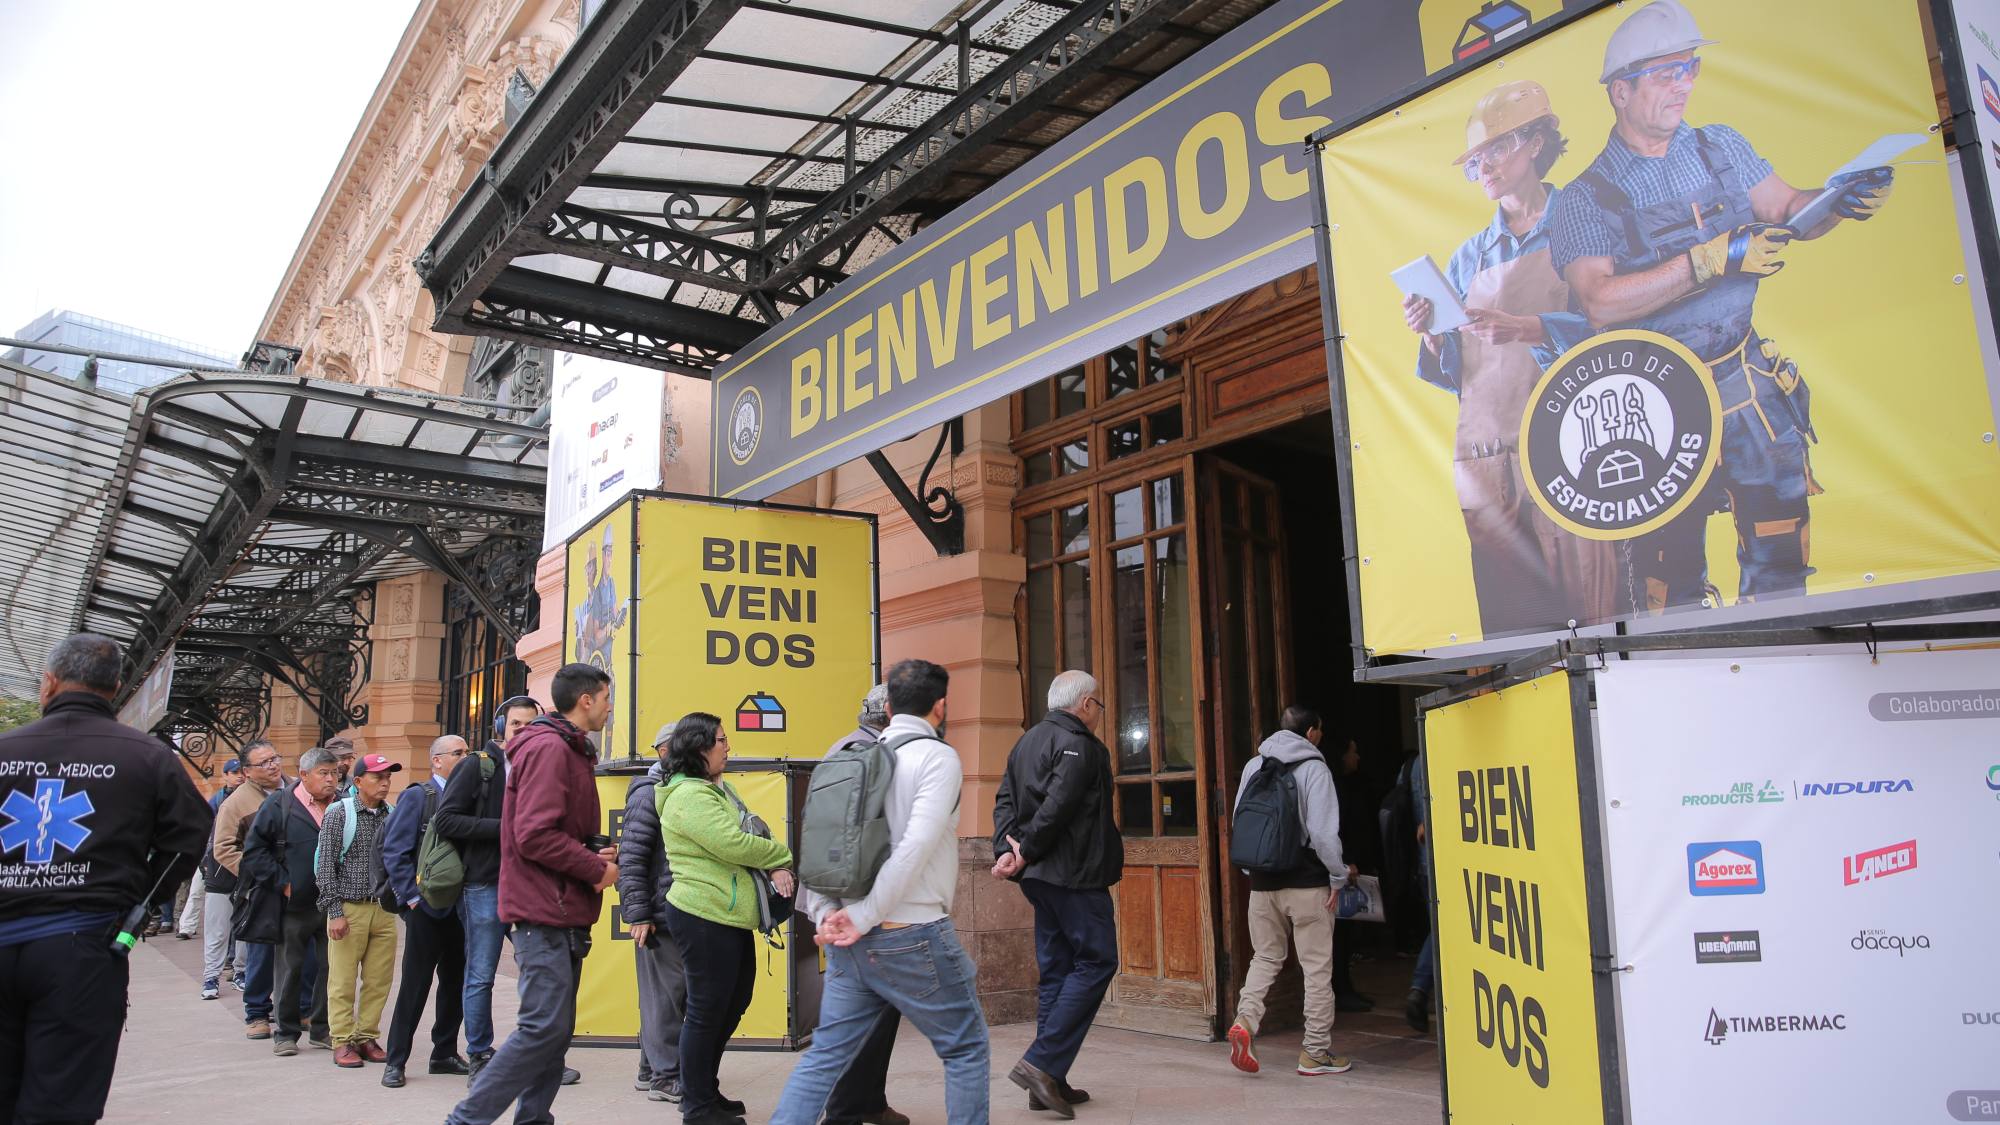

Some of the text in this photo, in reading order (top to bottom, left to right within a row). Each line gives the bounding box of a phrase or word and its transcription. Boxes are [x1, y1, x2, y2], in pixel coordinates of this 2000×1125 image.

[790, 62, 1333, 439] BIENVENIDOS
[1546, 351, 1674, 414] CIRCULO DE
[1546, 432, 1703, 523] ESPECIALISTAS
[702, 536, 817, 579] BIEN
[699, 582, 817, 624] VENI
[706, 629, 815, 669] DOS
[0, 760, 116, 778] DEPTO. MEDICO
[1730, 782, 1754, 793] AIR
[1802, 779, 1914, 797] INDURA
[1457, 765, 1536, 852] BIEN
[1681, 792, 1755, 806] PRODUCTS
[1698, 862, 1753, 879] Agorex
[1844, 847, 1911, 887] LANCO
[1462, 868, 1545, 972] VENI
[1472, 968, 1549, 1089] DOS
[1729, 1014, 1847, 1033] TIMBERMAC
